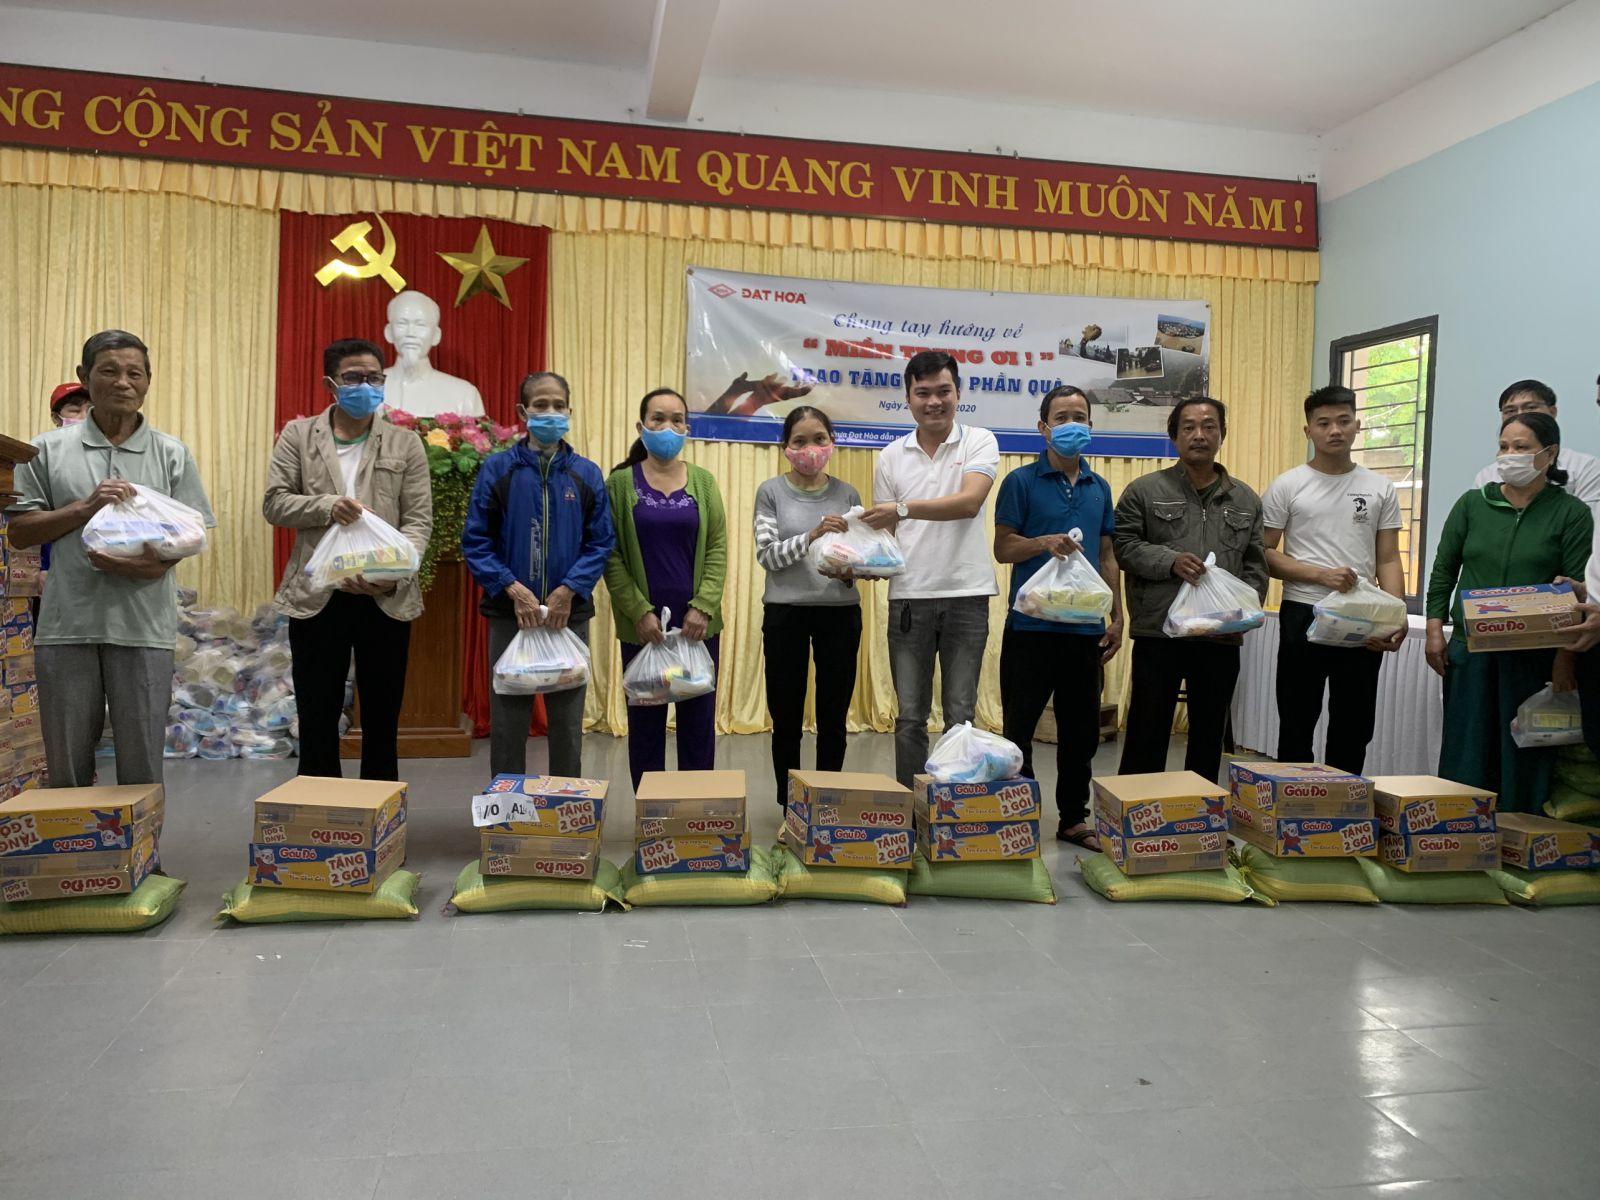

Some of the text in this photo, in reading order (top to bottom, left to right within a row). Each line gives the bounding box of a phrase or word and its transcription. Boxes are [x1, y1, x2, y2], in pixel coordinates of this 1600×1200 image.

[83, 87, 253, 148] CỘNG
[270, 101, 386, 160] SẢN
[406, 121, 543, 177] VIỆT
[557, 137, 681, 185] NAM
[696, 150, 874, 203] QUANG
[891, 166, 1020, 212] VINH
[1034, 173, 1172, 224] MUÔN
[833, 311, 893, 335] Chung
[900, 320, 931, 339] tay
[969, 371, 1022, 392] PHẦN
[879, 400, 903, 411] Ngày
[1002, 805, 1009, 814] 2
[560, 820, 568, 831] 2
[1002, 844, 1009, 853] 2
[1344, 841, 1351, 851] 2
[878, 852, 886, 861] 2
[331, 873, 340, 884] 2
